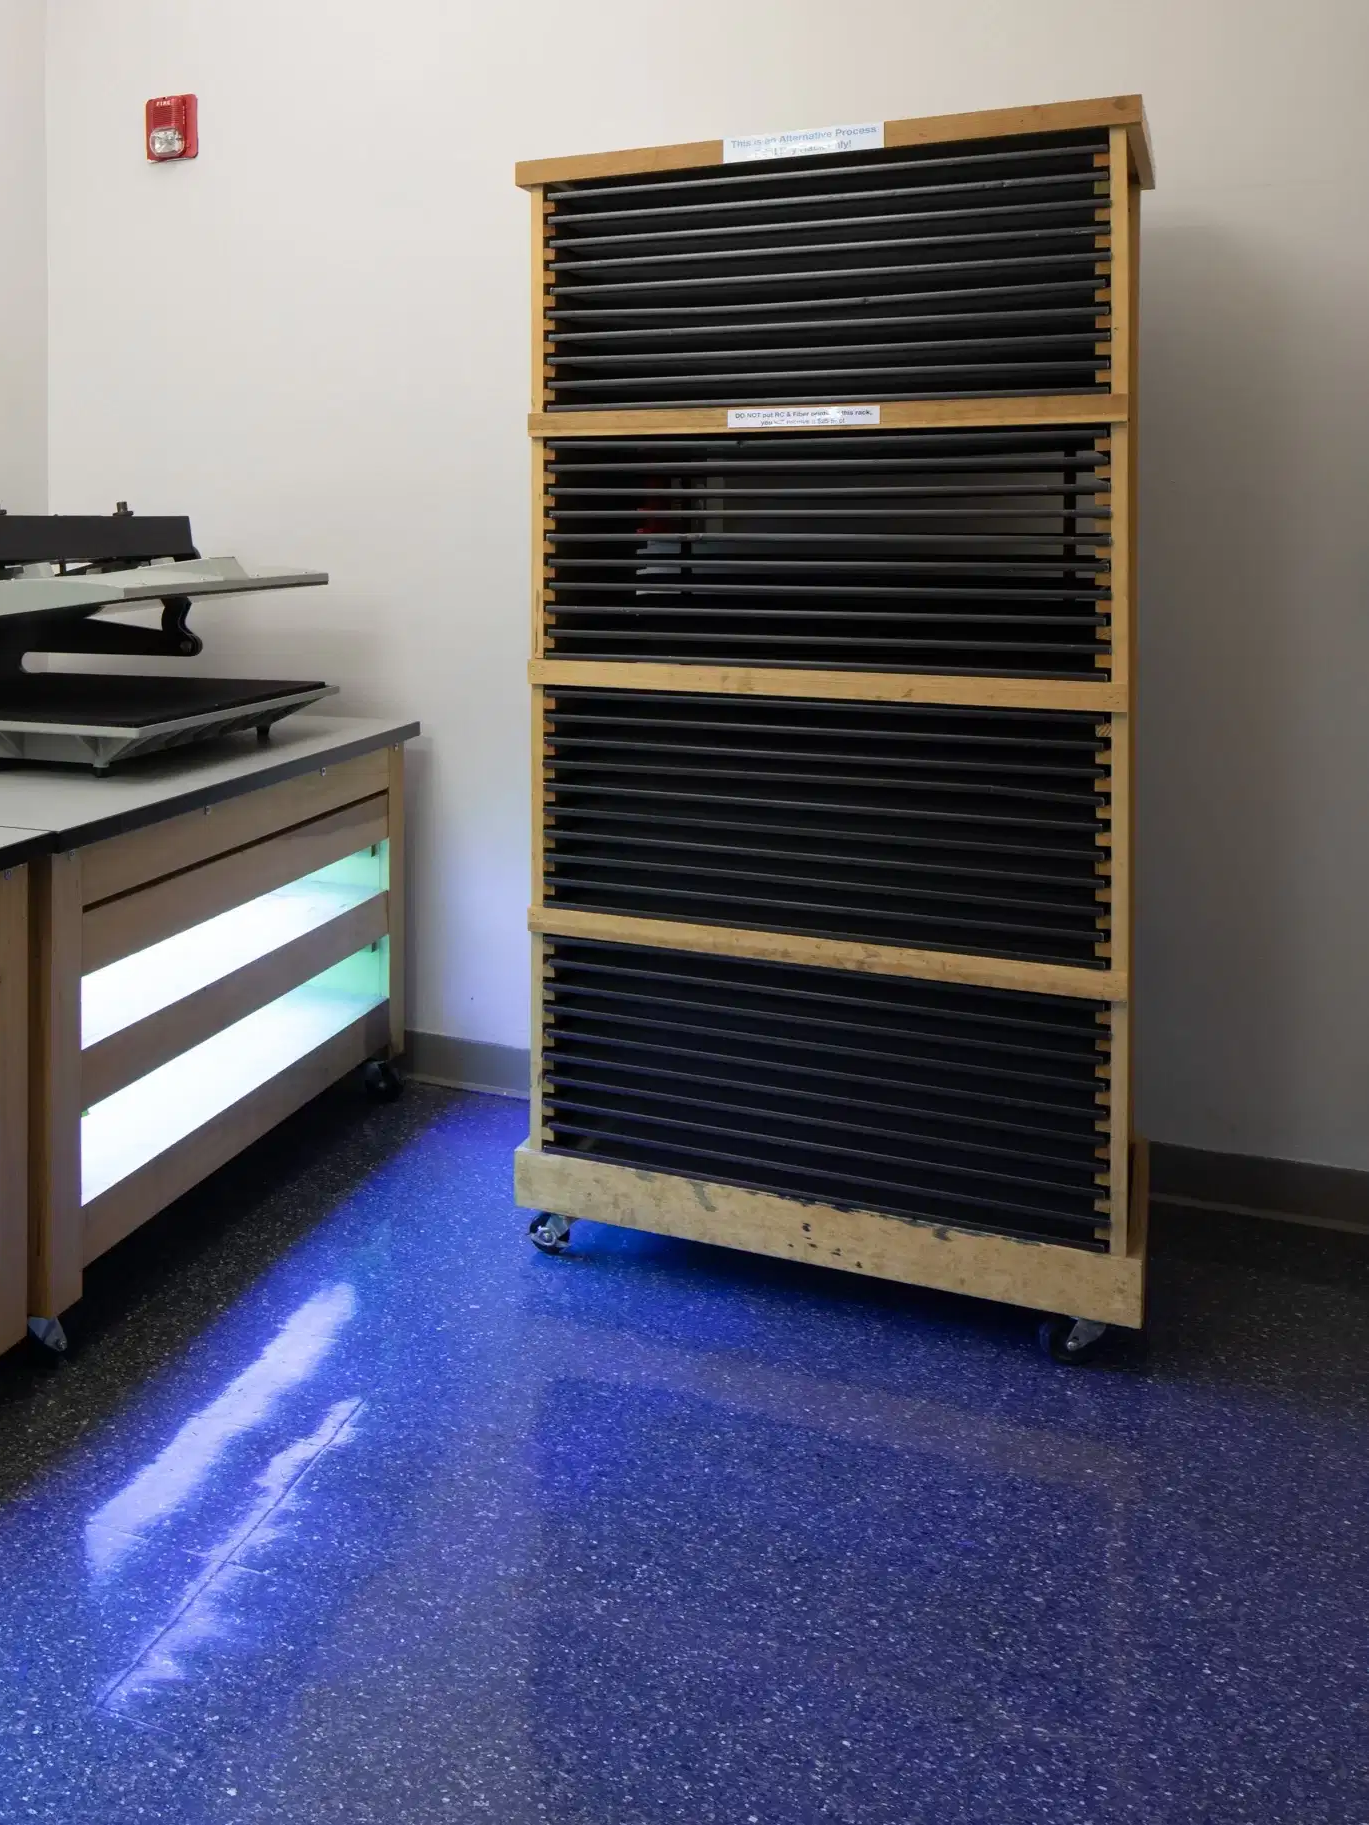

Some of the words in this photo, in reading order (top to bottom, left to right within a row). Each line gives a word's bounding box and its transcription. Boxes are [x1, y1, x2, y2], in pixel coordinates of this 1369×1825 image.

[731, 140, 751, 149] This
[754, 138, 762, 146] is
[764, 137, 777, 145] an
[779, 130, 832, 143] Alternative
[835, 126, 877, 137] Process
[760, 419, 773, 427] you
